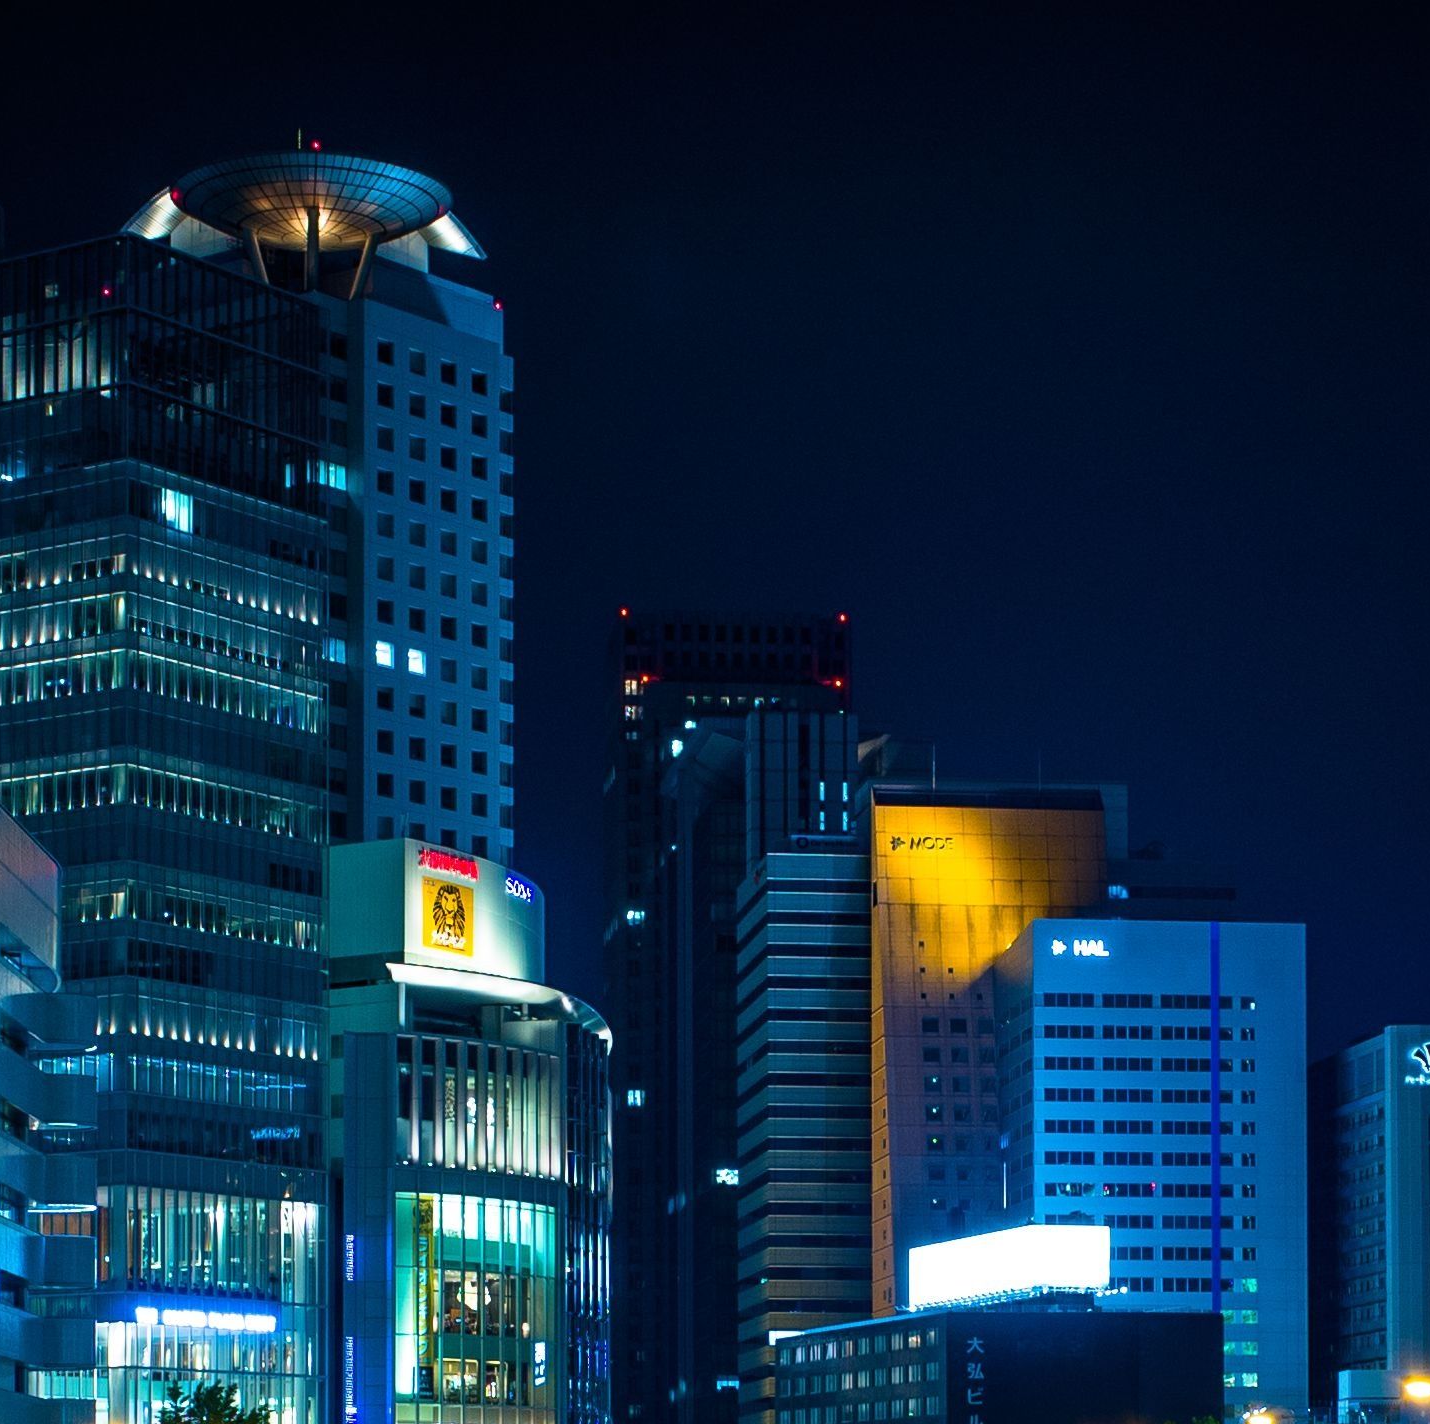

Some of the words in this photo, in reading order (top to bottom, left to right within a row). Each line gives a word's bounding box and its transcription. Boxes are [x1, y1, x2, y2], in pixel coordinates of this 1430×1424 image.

[909, 836, 954, 850] MODE
[505, 877, 532, 903] SONY
[1073, 939, 1110, 957] HAL
